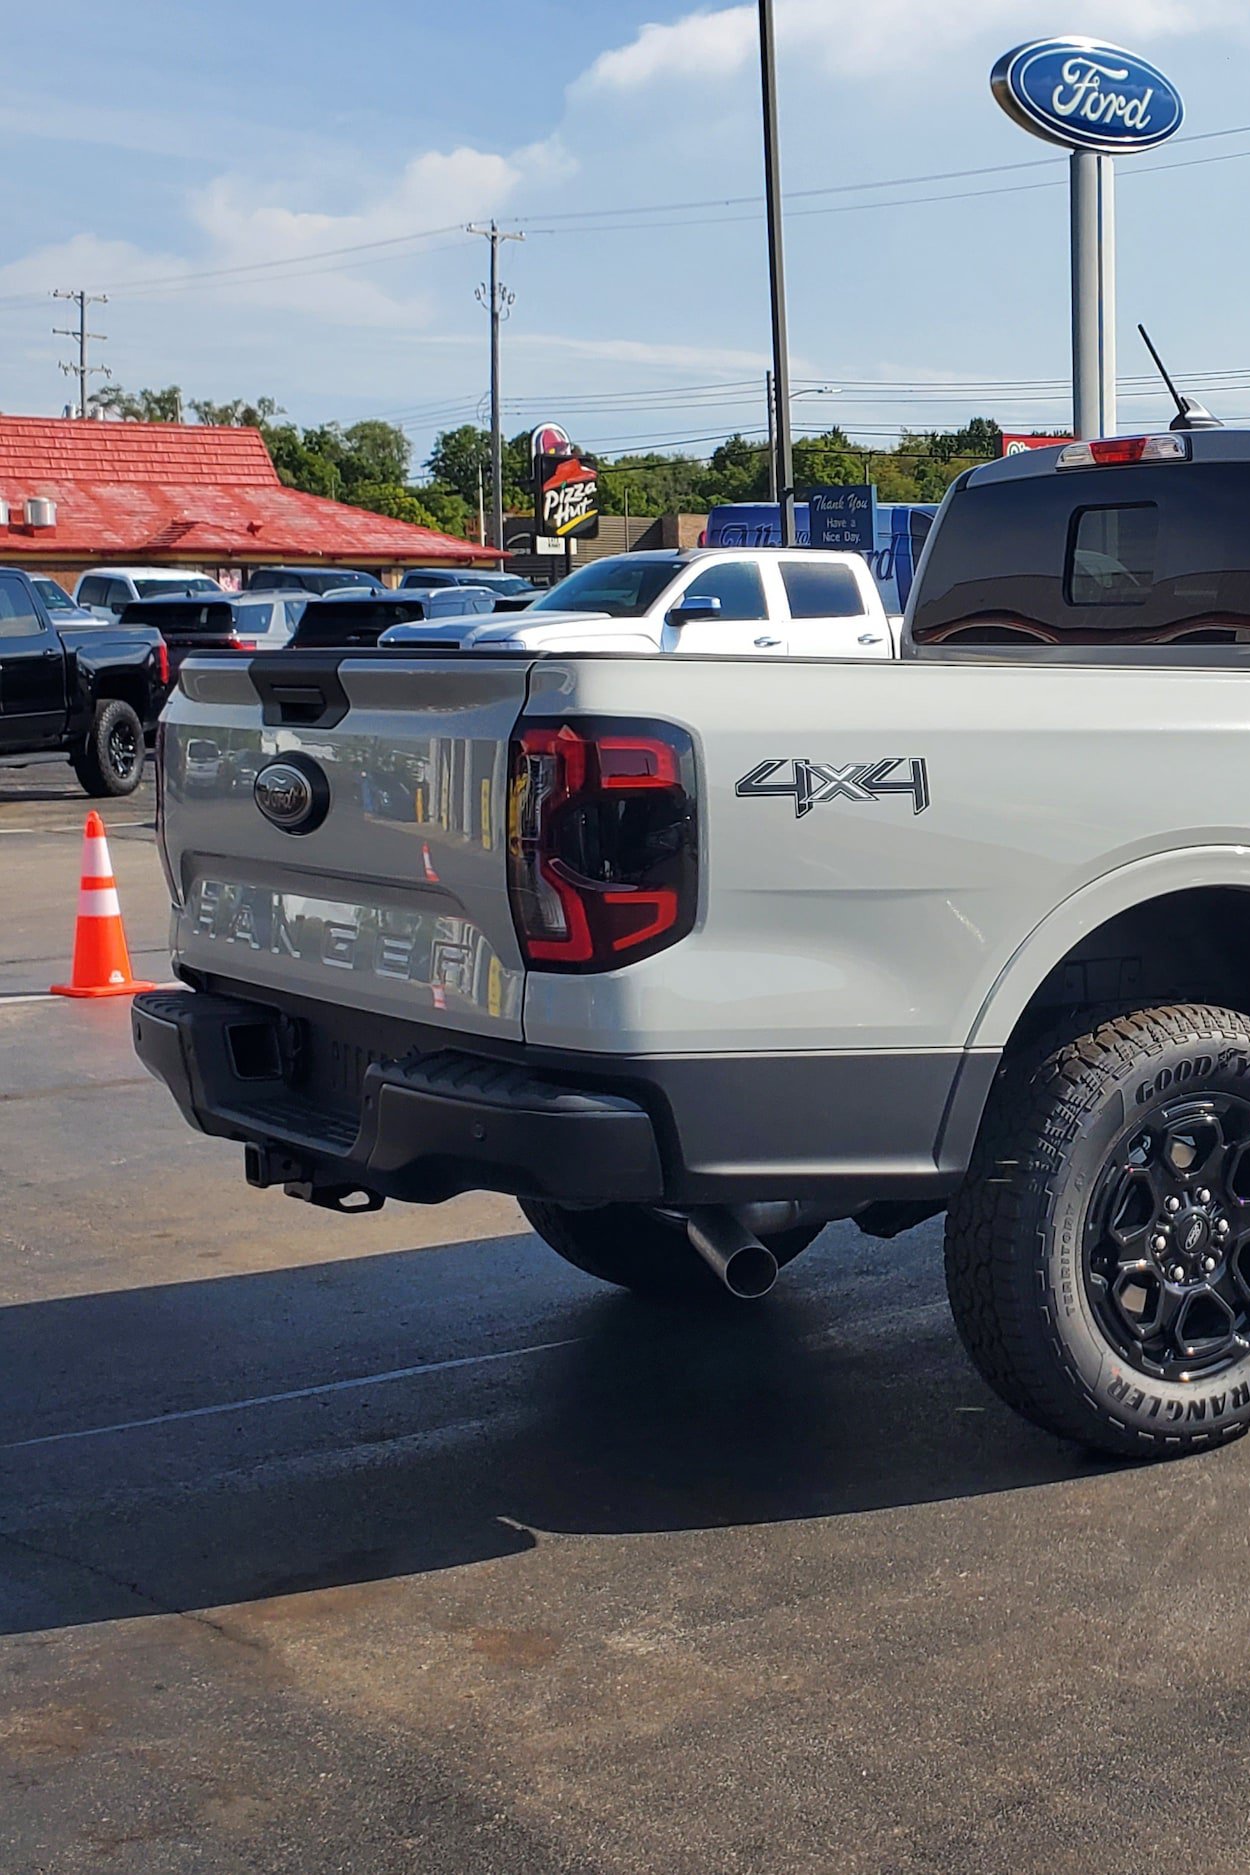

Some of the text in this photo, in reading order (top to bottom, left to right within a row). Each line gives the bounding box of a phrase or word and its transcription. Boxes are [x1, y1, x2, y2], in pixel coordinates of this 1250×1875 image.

[1052, 57, 1154, 130] Ford
[544, 481, 597, 521] Pizza
[553, 496, 594, 527] Hut
[813, 492, 868, 514] Thank You
[822, 531, 861, 544] Nice Day.
[826, 517, 856, 528] Have a
[192, 880, 476, 995] RANGER
[1060, 1203, 1076, 1318] TERRITORY
